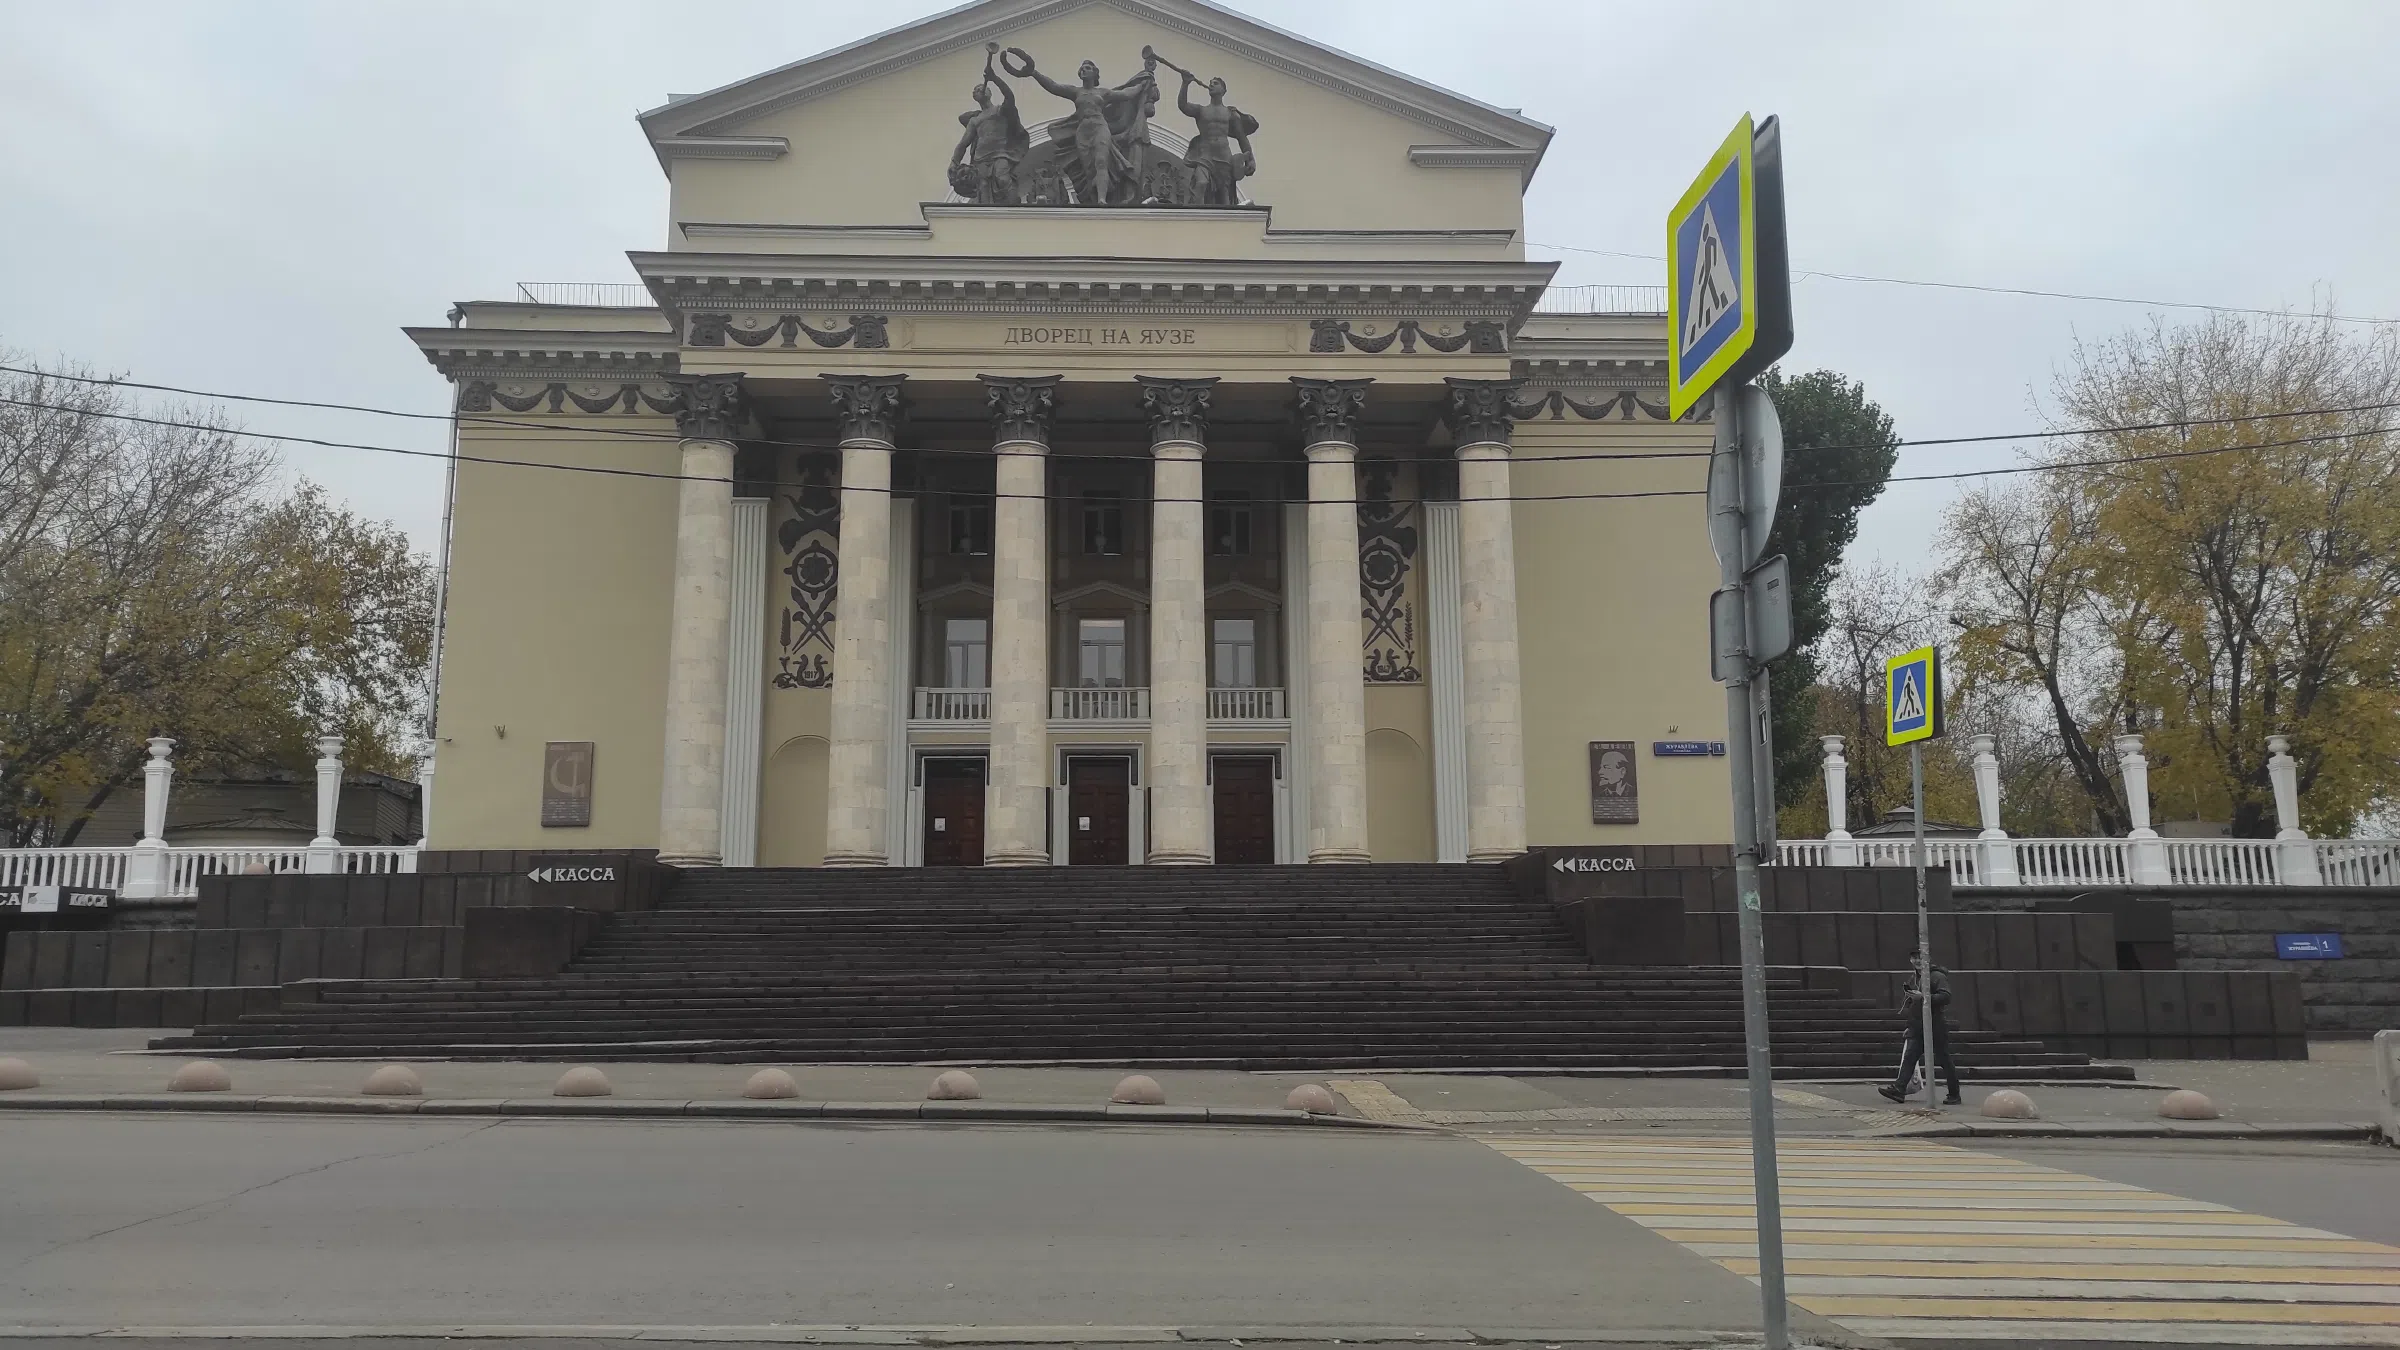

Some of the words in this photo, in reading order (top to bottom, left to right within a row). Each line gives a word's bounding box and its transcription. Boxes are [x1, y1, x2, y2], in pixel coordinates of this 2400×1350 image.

[1004, 328, 1093, 346] ДВОРЕЦ
[1101, 329, 1131, 344] НА
[1139, 329, 1195, 345] ЯУЗЕ
[804, 670, 818, 679] 1917
[1578, 858, 1637, 872] КАССА
[554, 867, 616, 882] КАССА
[2322, 940, 2329, 949] 1
